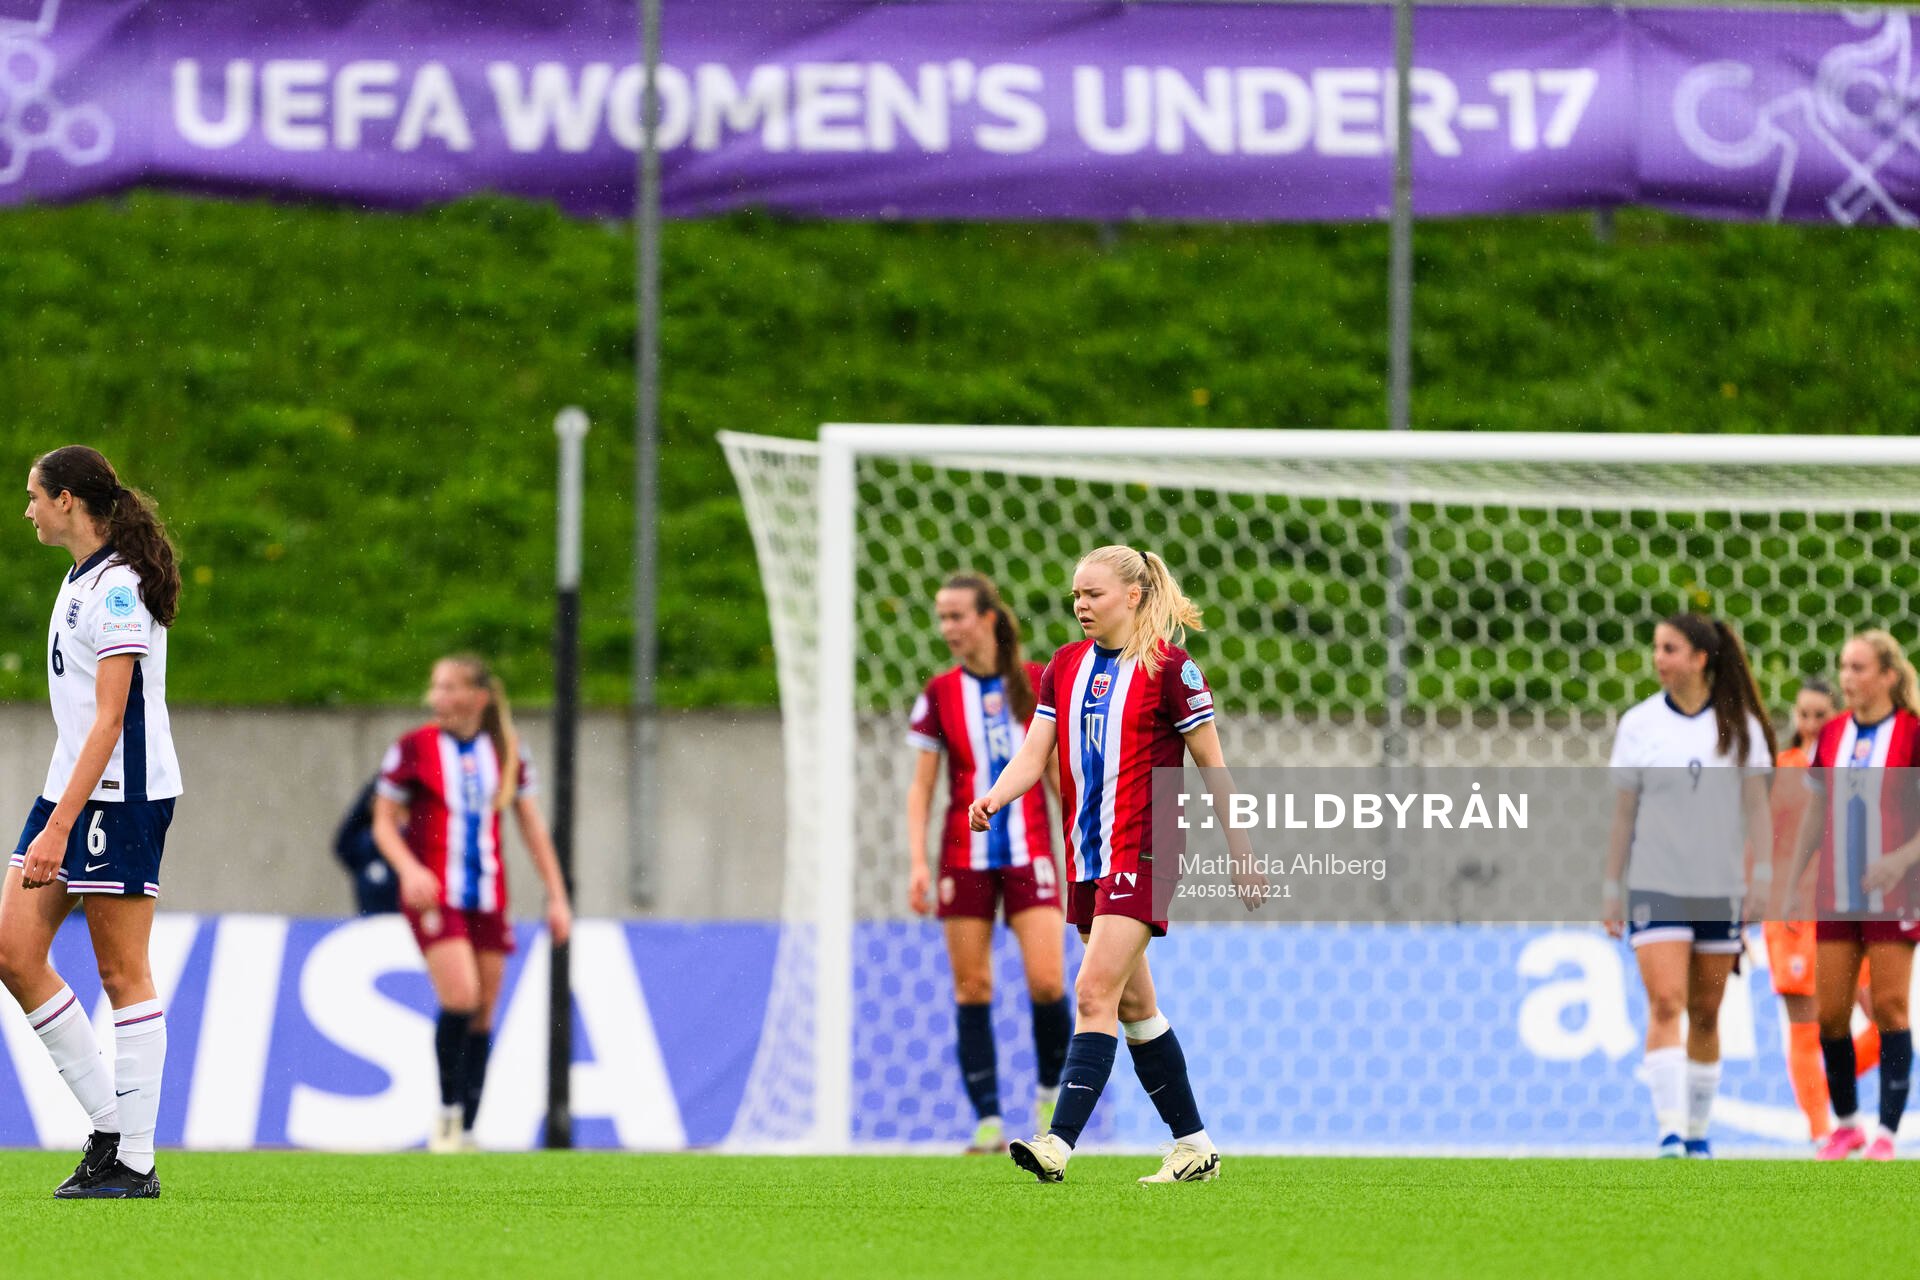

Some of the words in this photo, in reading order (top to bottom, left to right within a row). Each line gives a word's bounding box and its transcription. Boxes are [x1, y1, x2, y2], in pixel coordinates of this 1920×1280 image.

[173, 58, 475, 152] UEFA
[487, 58, 1046, 155] WOMEN'S
[1072, 66, 1598, 157] UNDER-17
[52, 631, 65, 677] 6
[1084, 713, 1105, 756] 10
[1688, 757, 1702, 792] 9
[87, 810, 107, 856] 6
